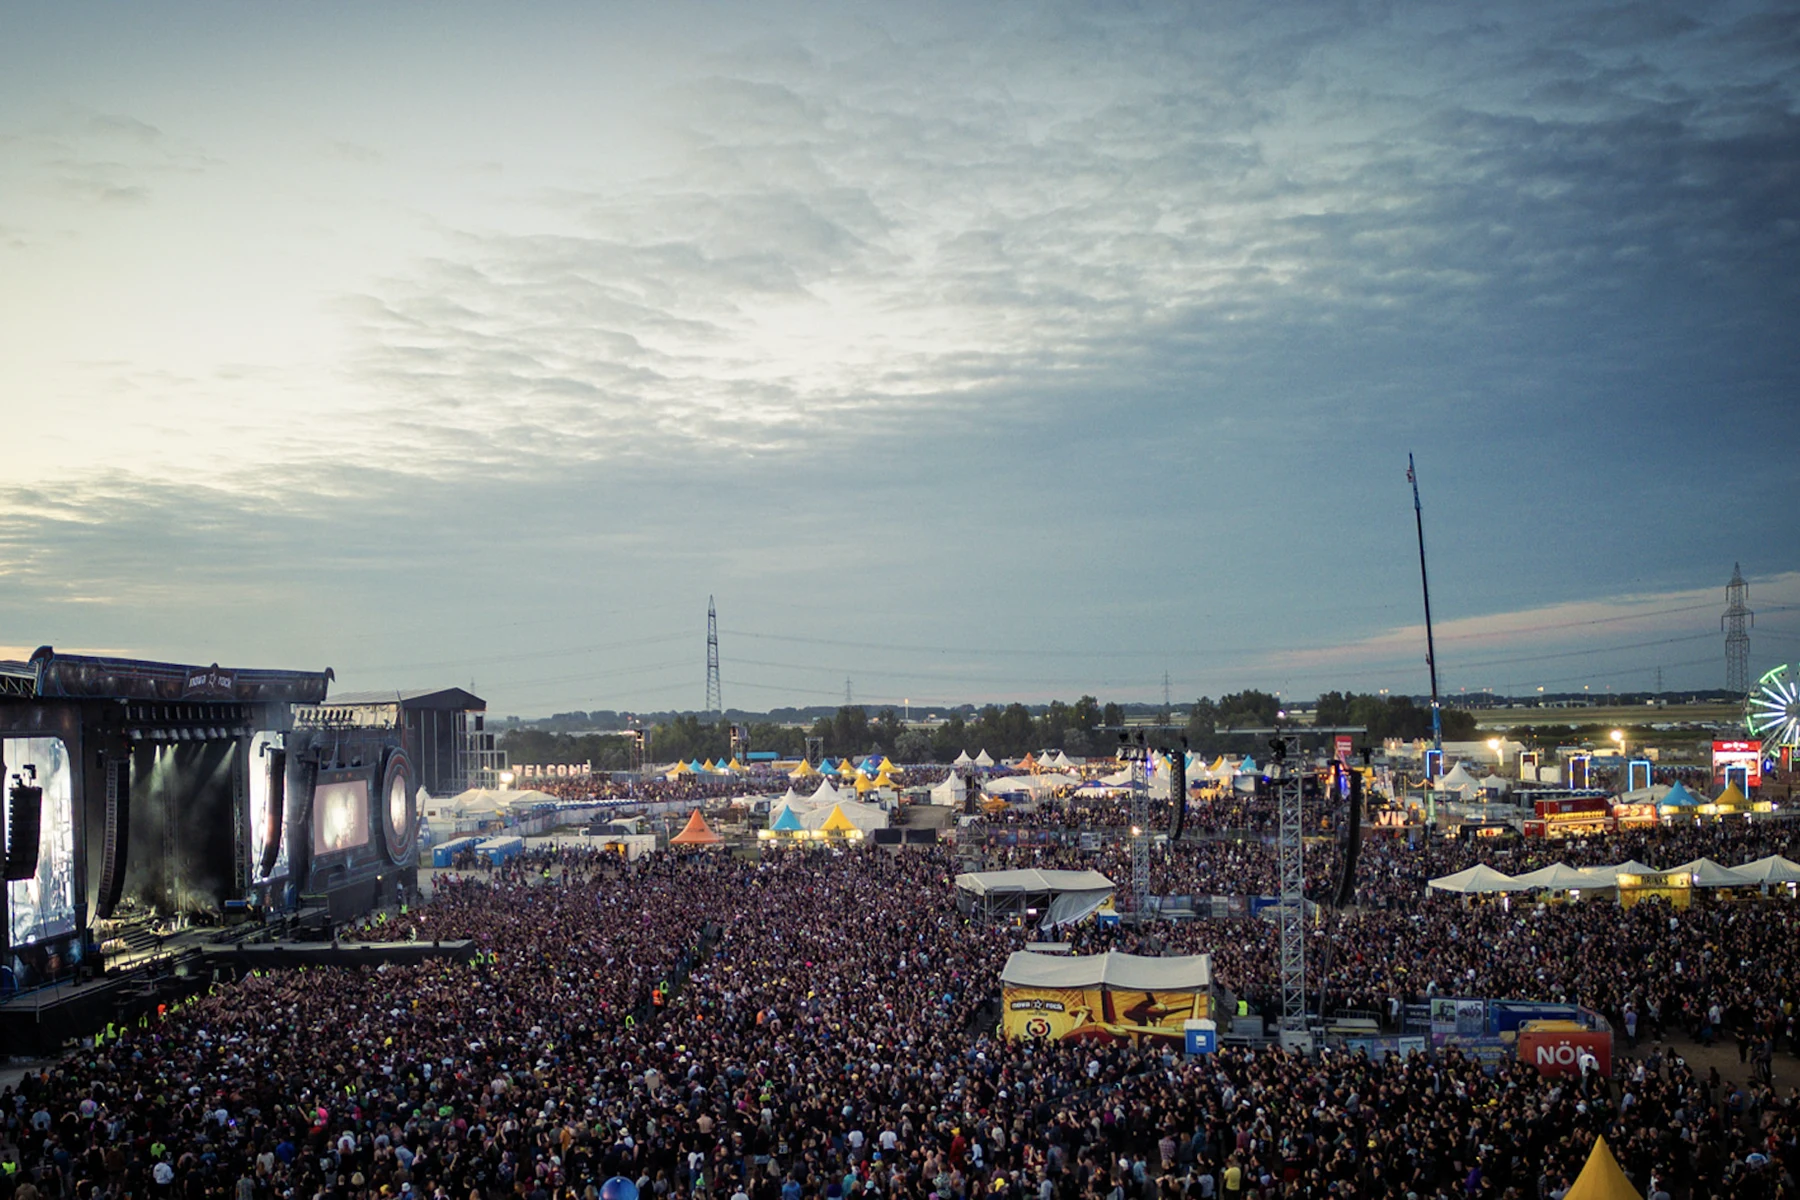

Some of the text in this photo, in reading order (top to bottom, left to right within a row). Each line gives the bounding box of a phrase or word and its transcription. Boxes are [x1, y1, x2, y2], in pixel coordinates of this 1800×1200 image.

[511, 764, 591, 778] WELCOME
[1378, 811, 1409, 827] VIP
[1641, 875, 1669, 886] DRINKS
[1011, 1001, 1063, 1011] nova rock
